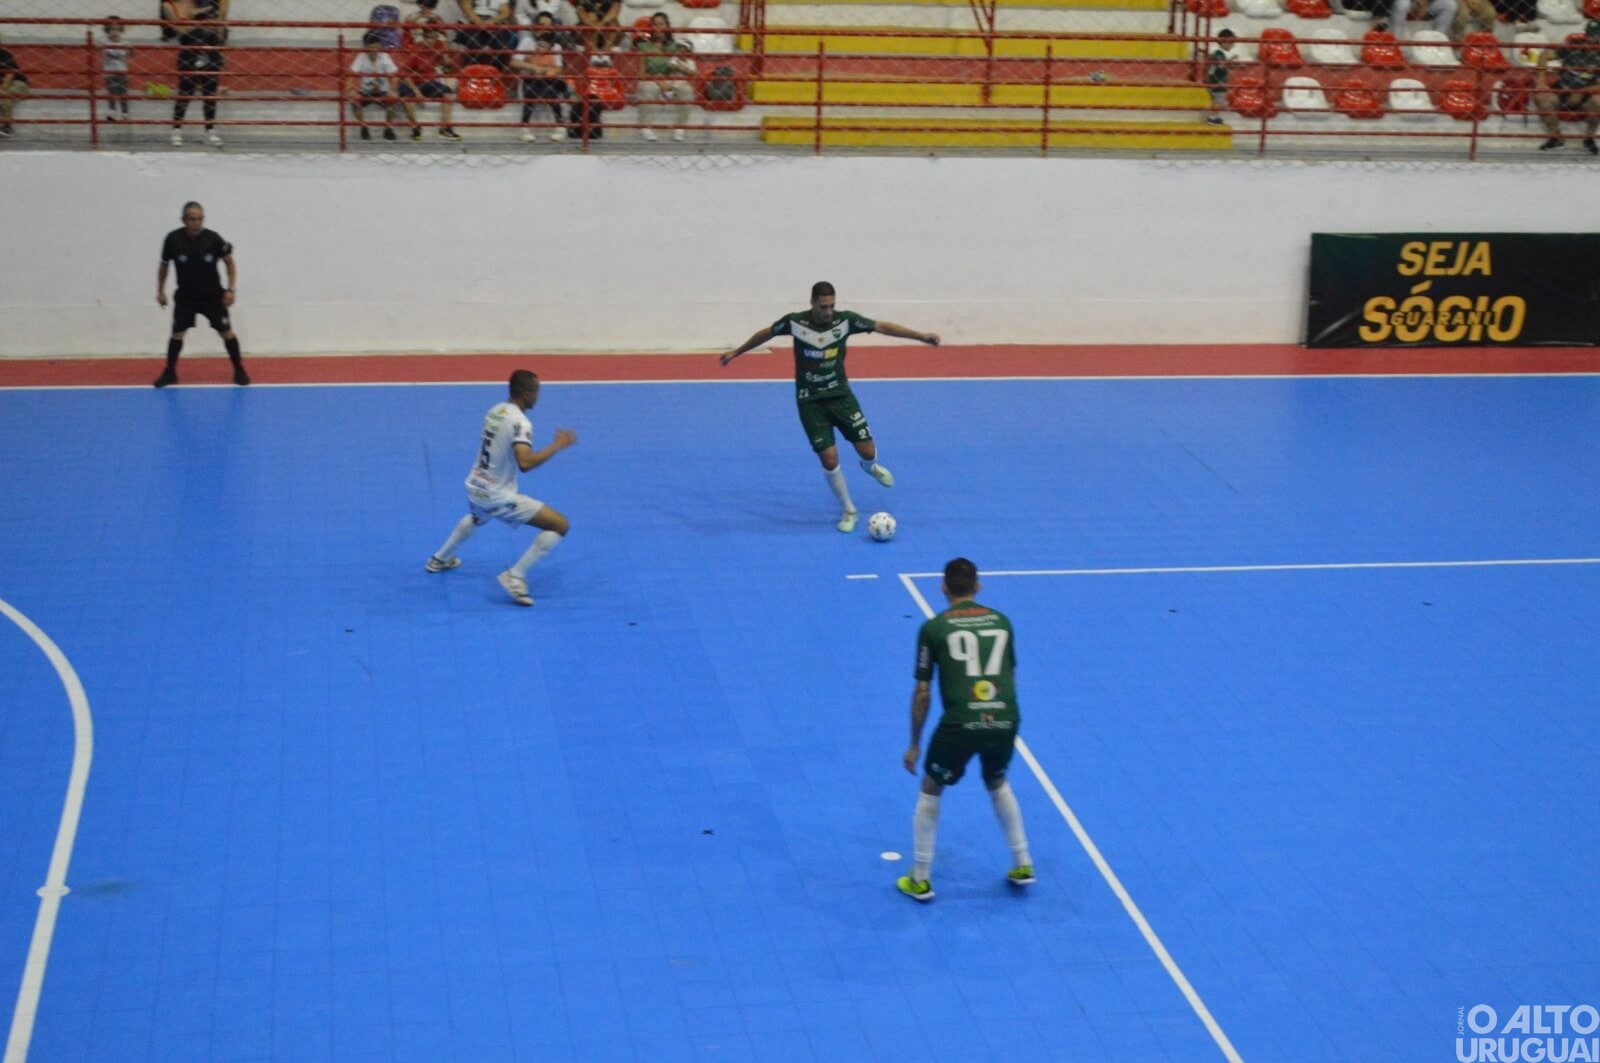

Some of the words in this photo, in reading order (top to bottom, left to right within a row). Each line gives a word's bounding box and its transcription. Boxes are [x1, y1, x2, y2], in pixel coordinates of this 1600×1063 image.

[1397, 241, 1492, 276] SEJA
[1359, 281, 1526, 342] SÓCIO
[1390, 311, 1493, 326] GUARANI
[946, 629, 1008, 676] 97
